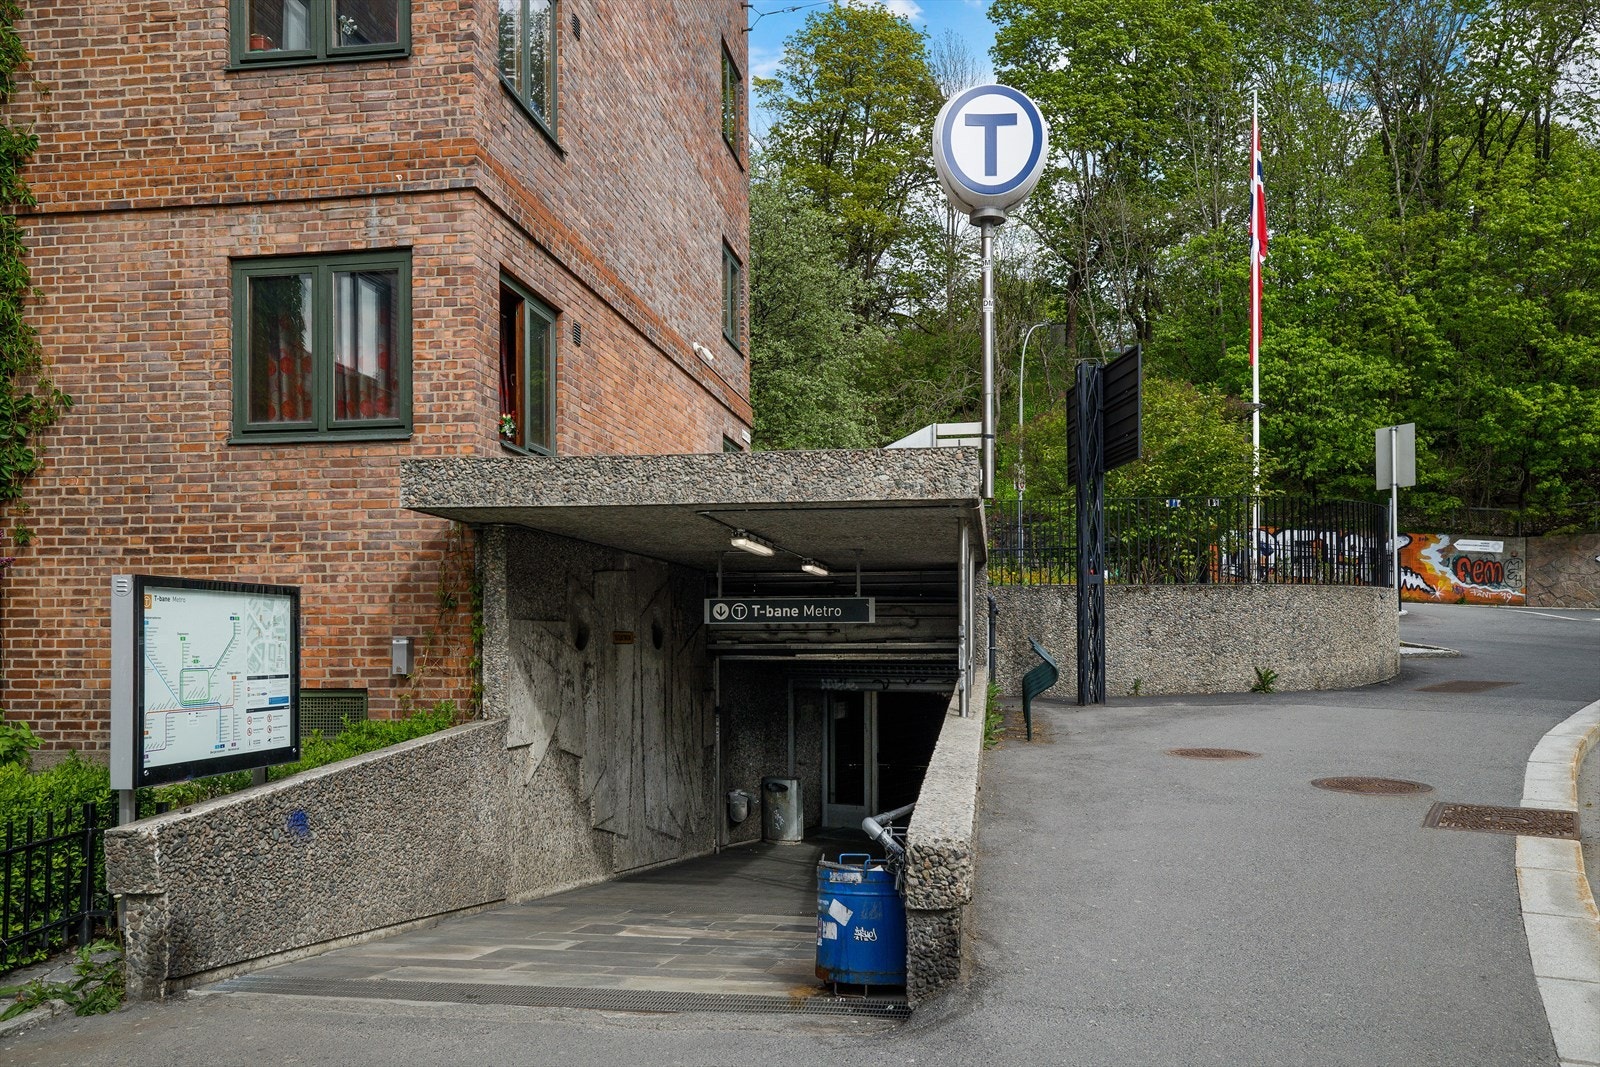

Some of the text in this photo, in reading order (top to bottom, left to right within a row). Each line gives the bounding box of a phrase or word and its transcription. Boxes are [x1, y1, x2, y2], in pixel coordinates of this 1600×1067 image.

[964, 113, 1018, 177] T
[154, 594, 186, 603] T-bane Metro
[752, 604, 799, 617] T-bane
[803, 604, 842, 617] Metro
